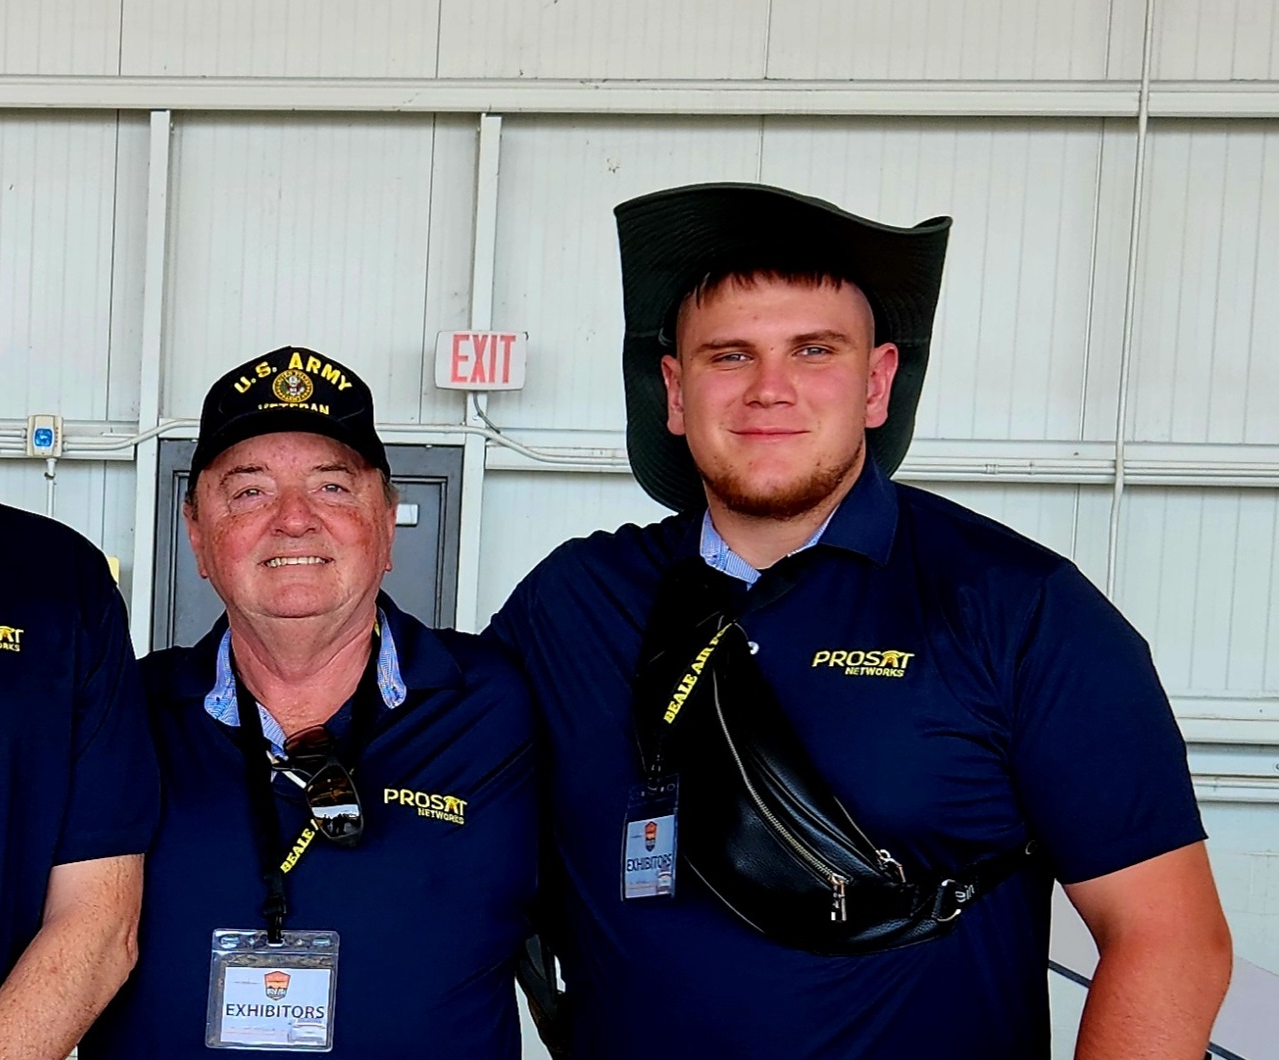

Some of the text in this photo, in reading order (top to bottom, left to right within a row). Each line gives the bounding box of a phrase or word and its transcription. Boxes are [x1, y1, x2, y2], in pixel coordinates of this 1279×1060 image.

[450, 333, 516, 383] EXIT
[234, 361, 278, 394] U.S.
[288, 352, 353, 392] ARMY
[811, 650, 915, 669] PROSAT
[844, 666, 904, 678] NETWORKS
[663, 673, 698, 724] BEALE
[383, 788, 467, 817] PROSAT
[416, 807, 465, 825] NETWORKS
[280, 828, 314, 873] BEALE
[225, 1002, 326, 1021] EXHIBITORS
